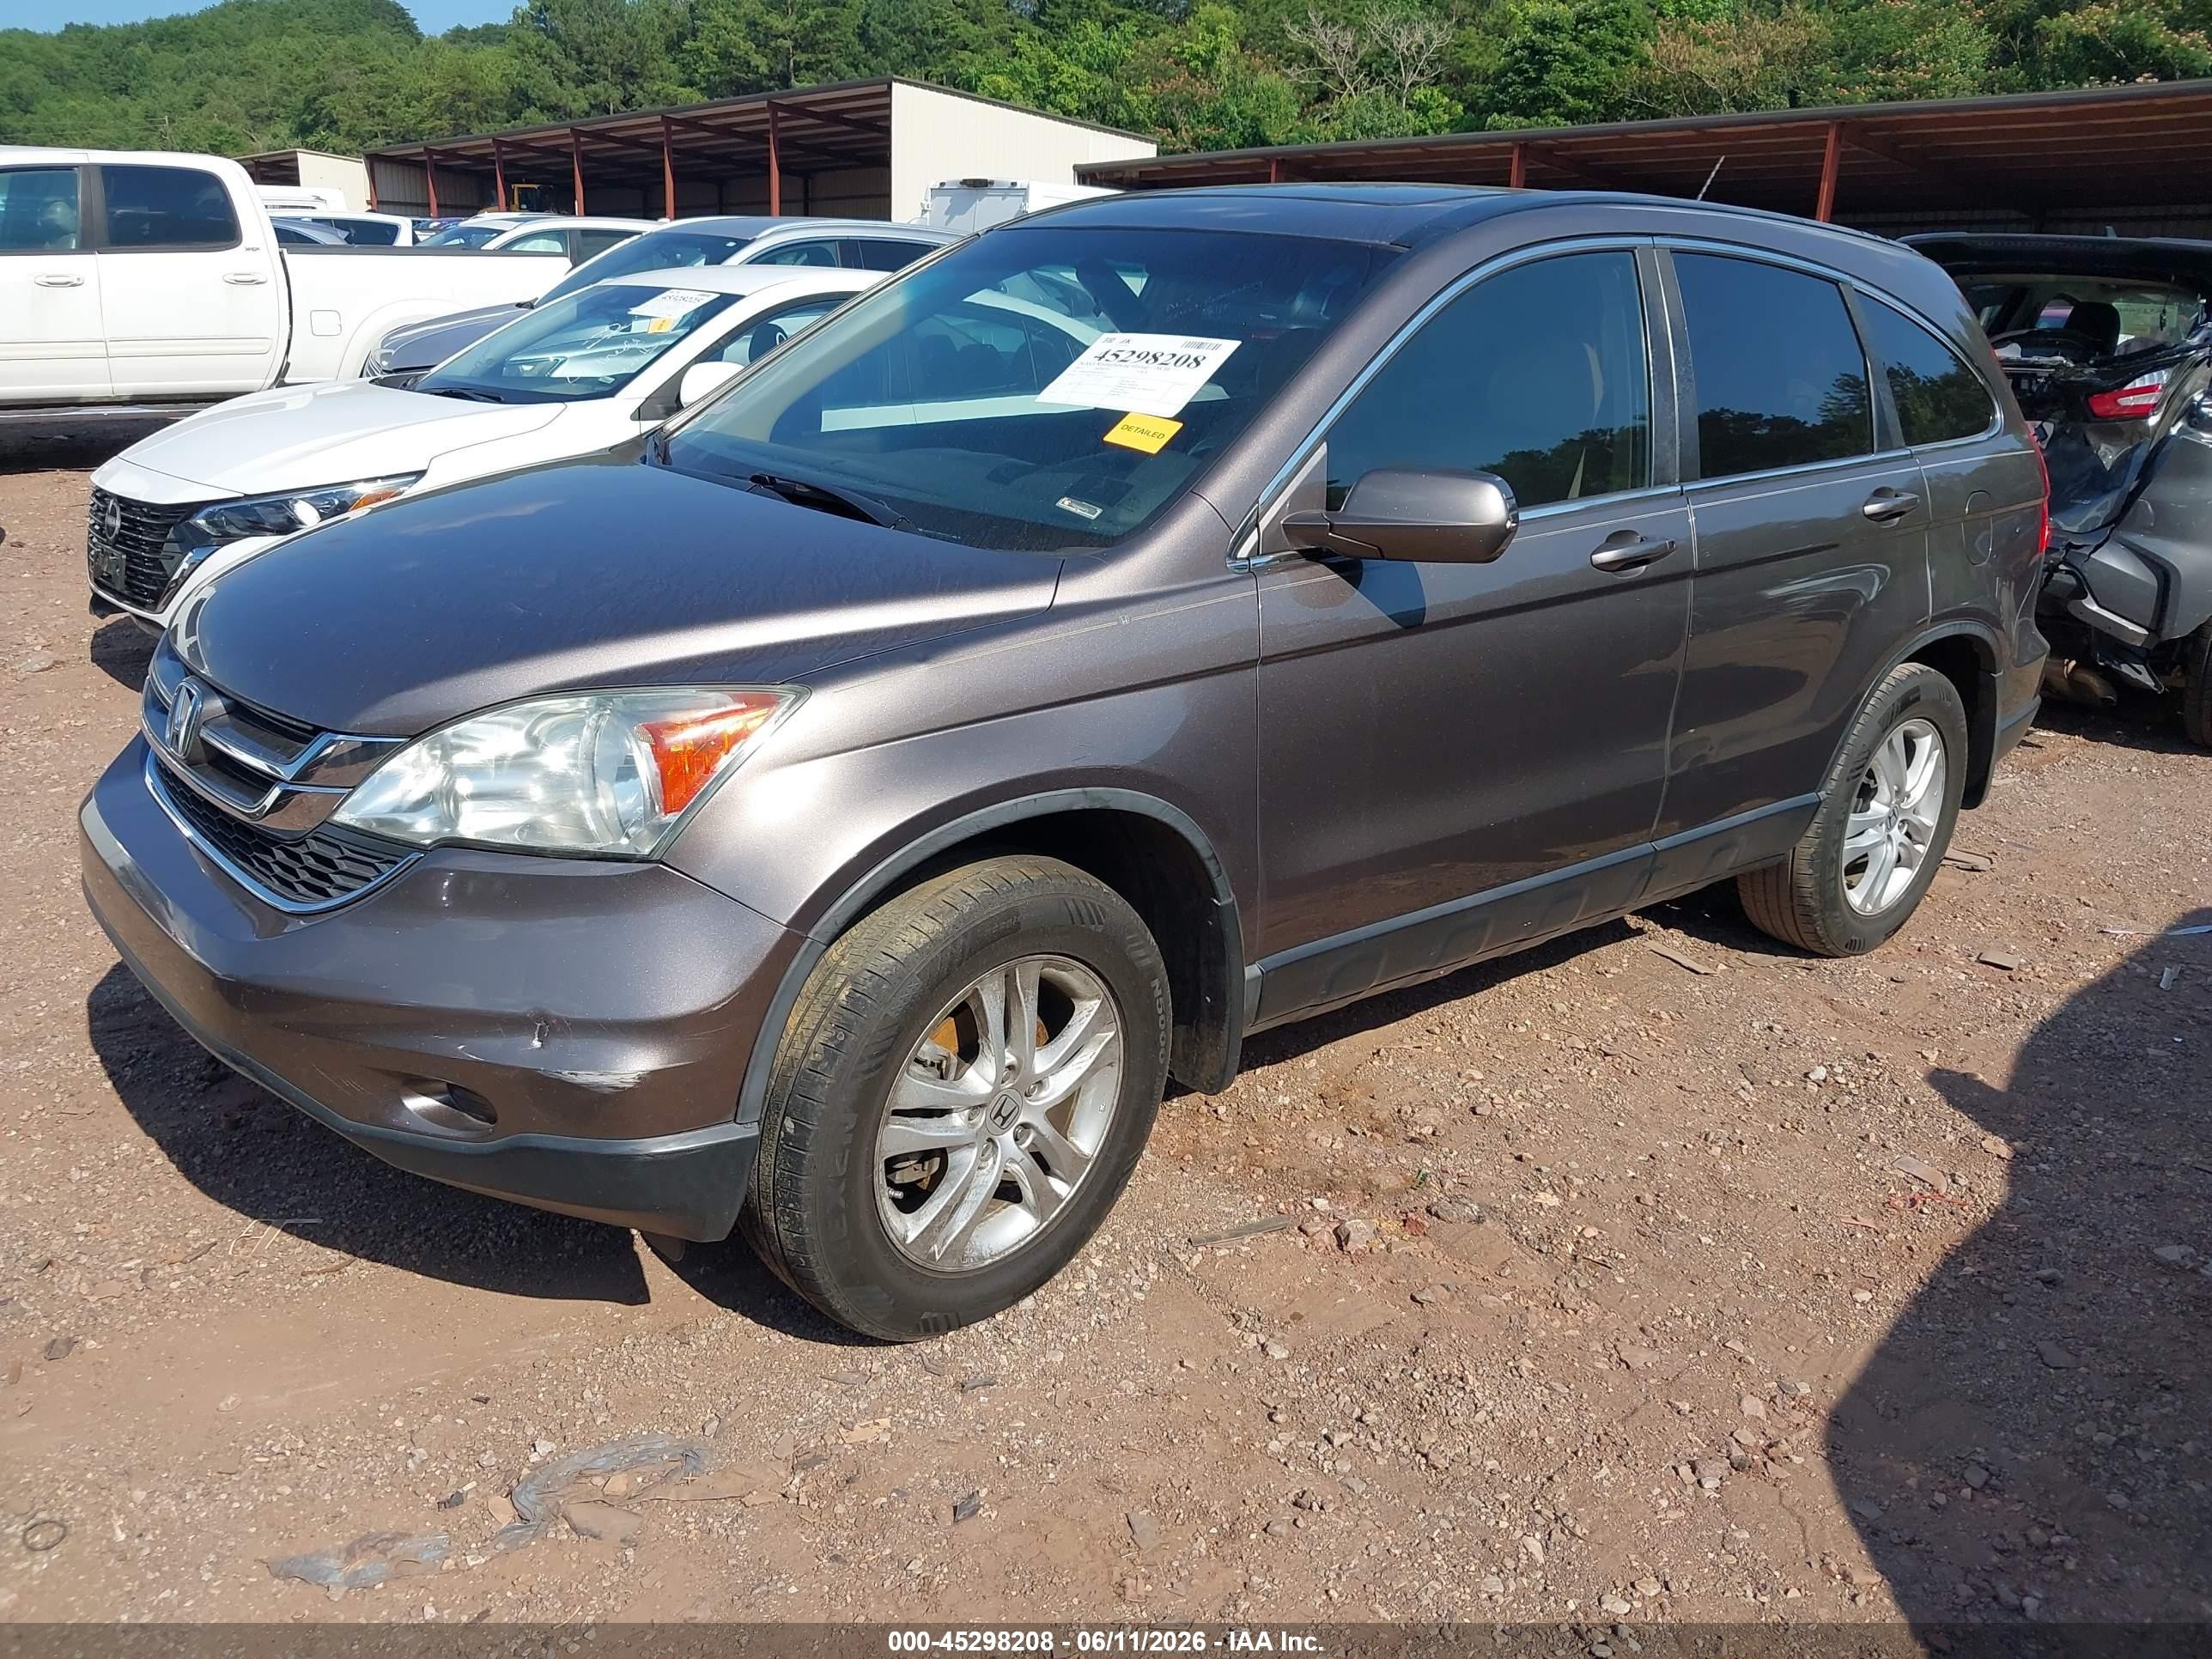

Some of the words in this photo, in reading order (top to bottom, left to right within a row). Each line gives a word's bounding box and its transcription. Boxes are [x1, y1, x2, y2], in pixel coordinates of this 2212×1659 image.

[1093, 349, 1206, 369] 45298208
[1121, 424, 1165, 440] DETAILED
[1149, 978, 1168, 1065] N5000
